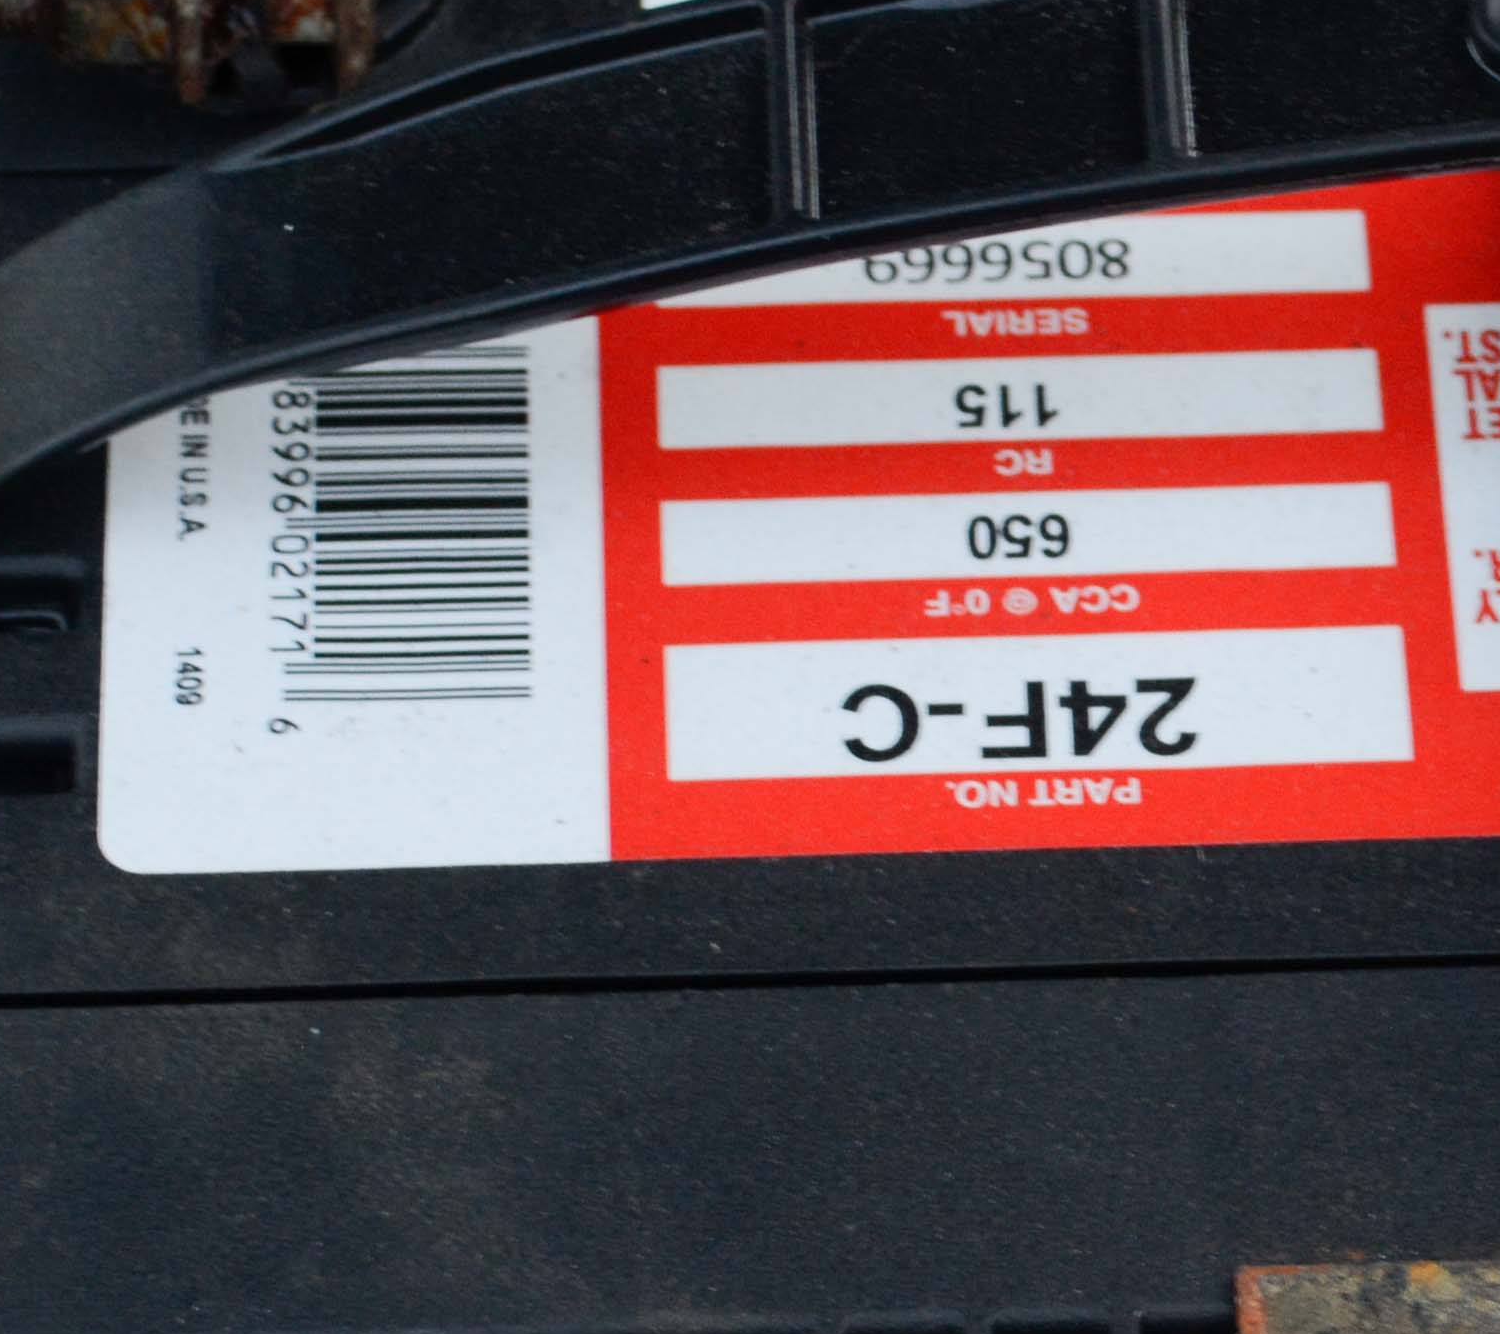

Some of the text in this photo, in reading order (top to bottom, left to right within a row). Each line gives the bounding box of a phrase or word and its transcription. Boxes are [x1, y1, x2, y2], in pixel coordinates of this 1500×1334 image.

[940, 307, 1091, 337] SERIAL
[953, 382, 1059, 428] 115
[180, 434, 210, 459] IN
[992, 446, 1054, 475] RC
[967, 513, 1071, 560] 650
[922, 582, 1141, 616] CCA @ 0°F
[175, 647, 203, 707] 1409
[841, 675, 1198, 763] 24F-C
[944, 776, 1142, 809] PART NO.
